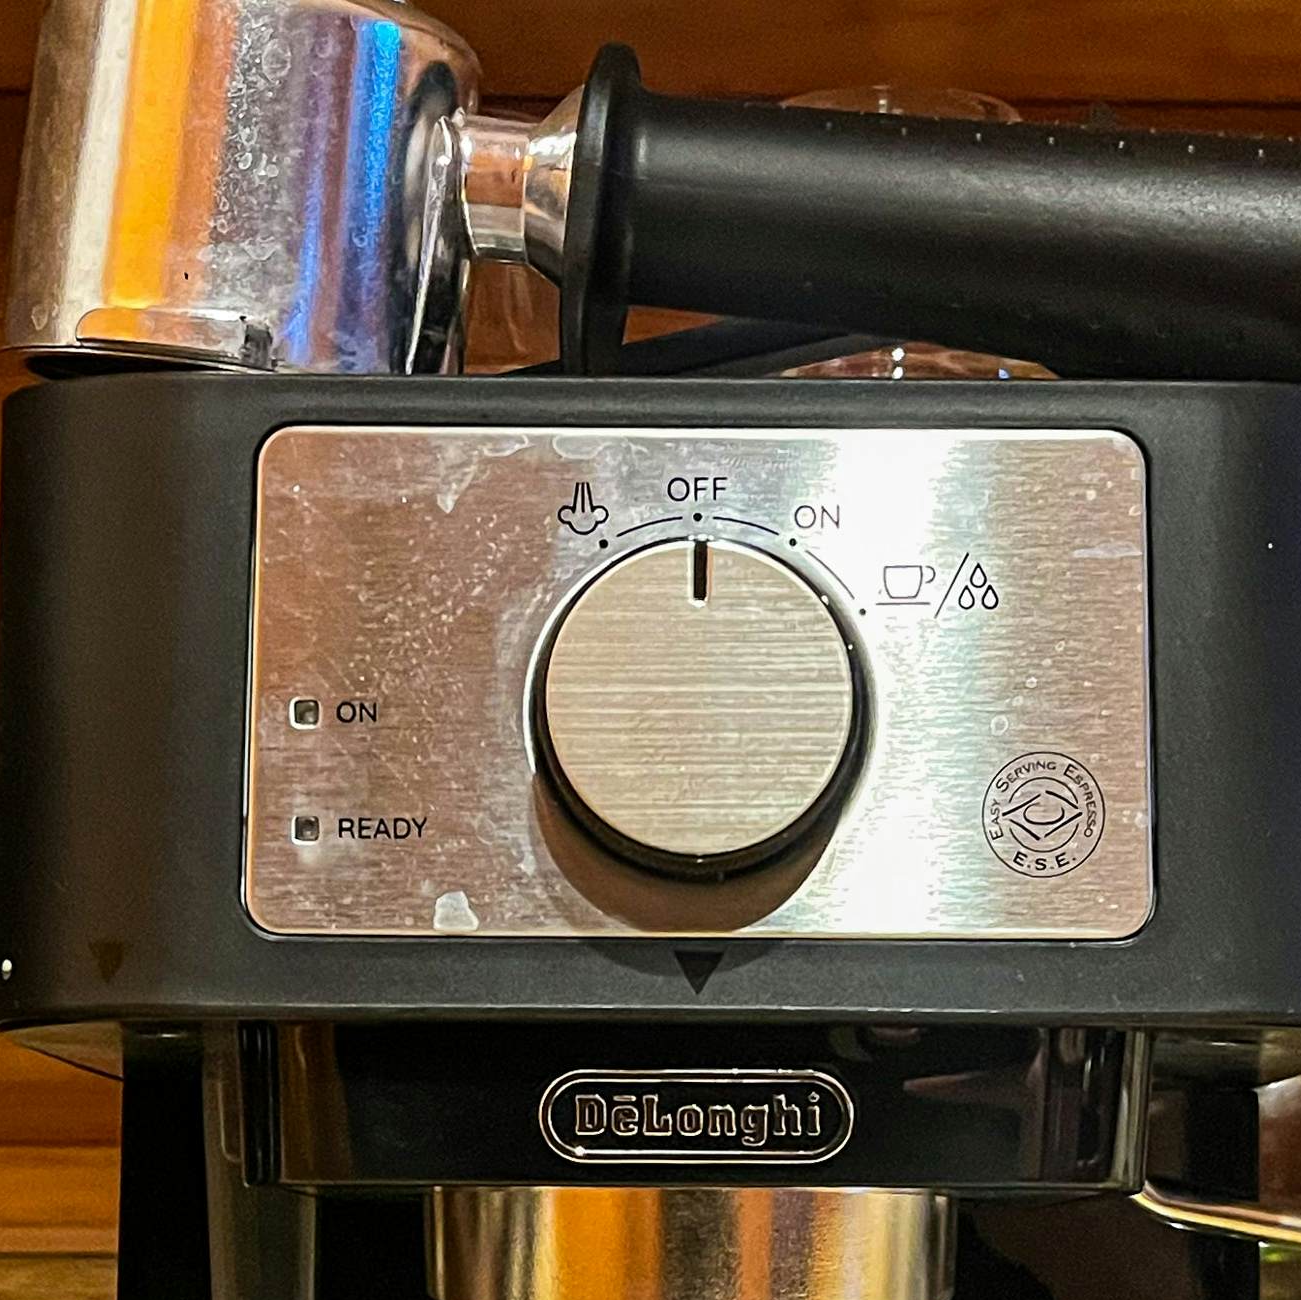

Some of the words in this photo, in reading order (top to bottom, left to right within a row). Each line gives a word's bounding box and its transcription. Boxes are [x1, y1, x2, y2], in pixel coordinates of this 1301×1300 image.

[667, 476, 728, 502] OFF
[794, 504, 841, 530] ON
[335, 701, 378, 723] ON
[337, 816, 428, 840] READY
[1012, 850, 1077, 871] E.S.E.
